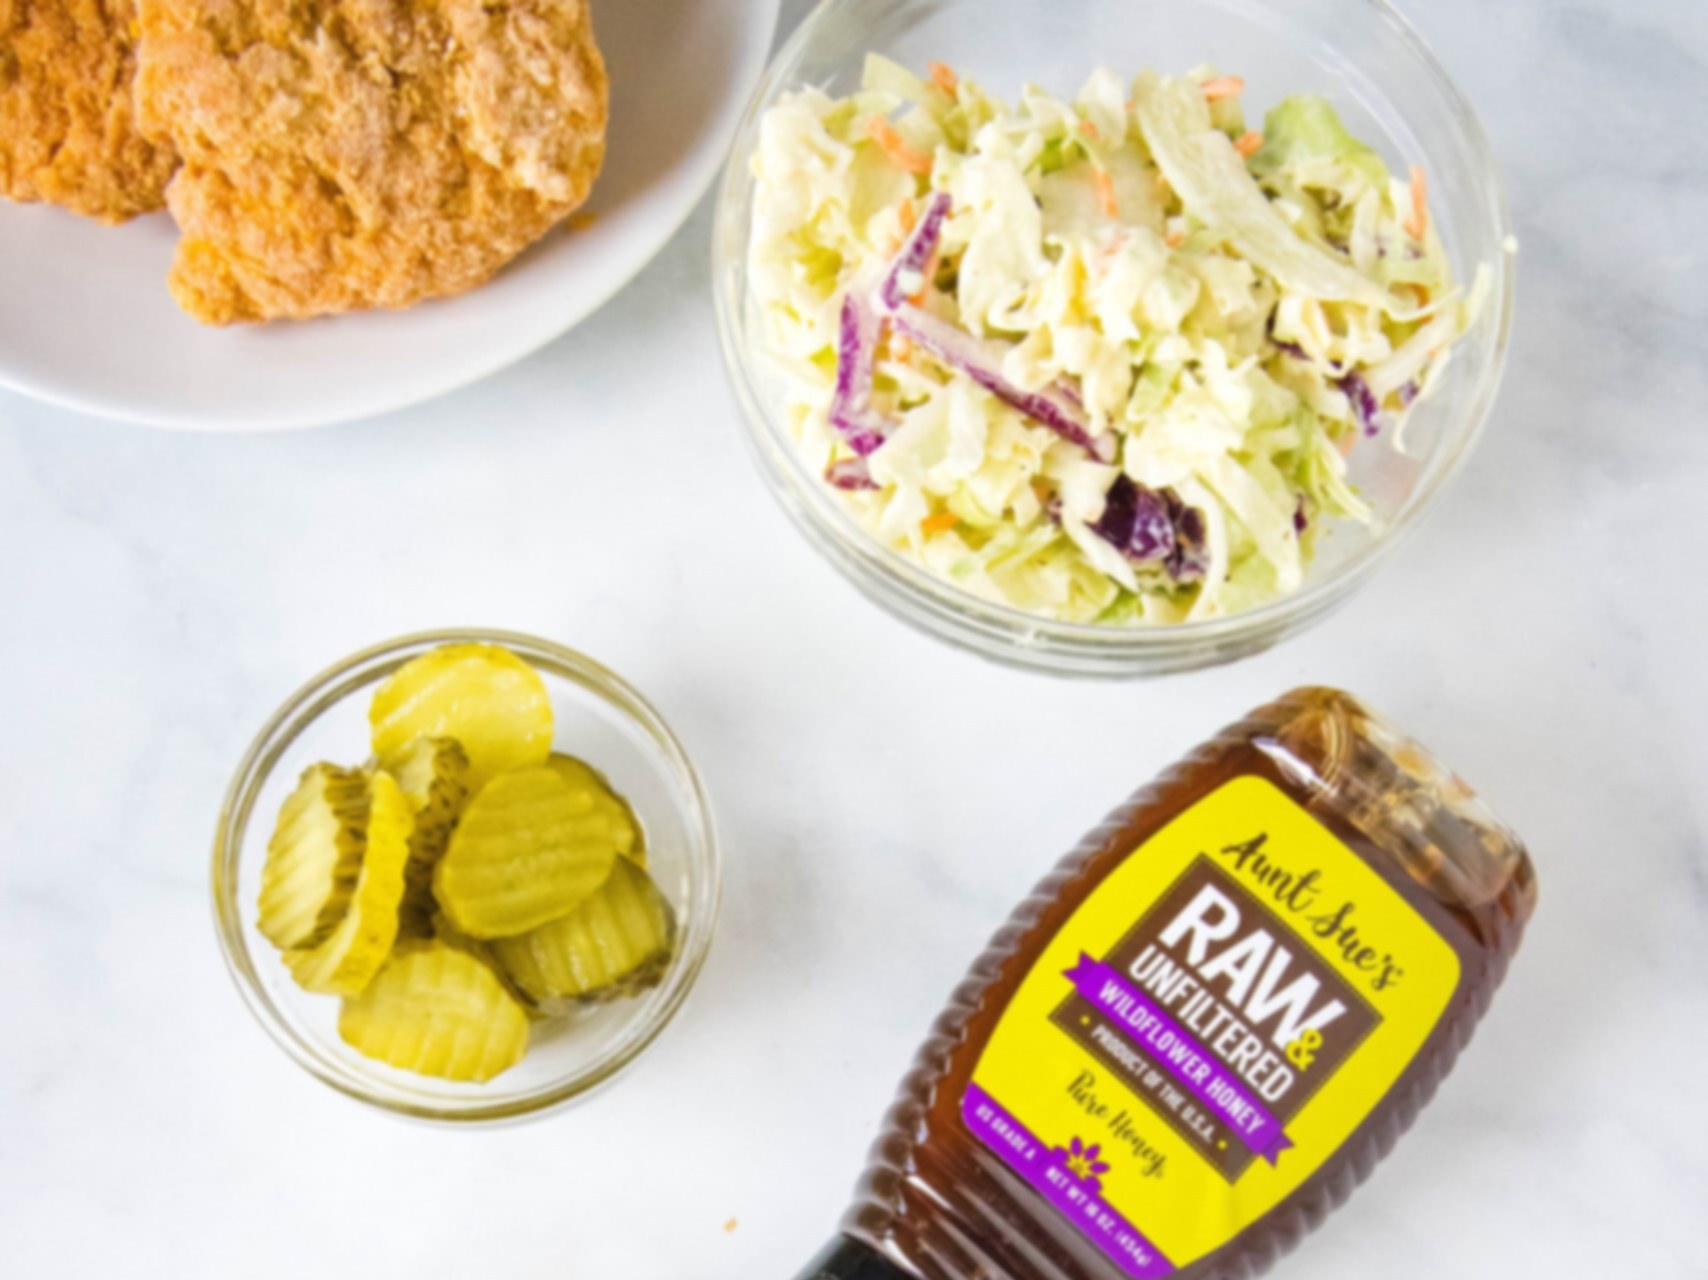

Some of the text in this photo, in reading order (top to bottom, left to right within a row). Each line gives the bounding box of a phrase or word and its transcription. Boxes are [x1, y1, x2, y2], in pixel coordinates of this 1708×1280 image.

[1158, 883, 1347, 1071] RAW &
[1221, 832, 1403, 991] Aunt Sue's
[1091, 1024, 1216, 1143] PRODUCT OF THE U.S.A.
[1099, 980, 1266, 1134] WILDFLOWER HONEY
[1129, 944, 1294, 1103] UNFILTERED
[991, 1118, 1027, 1152] GRADE
[1025, 1148, 1036, 1161] A
[1046, 1167, 1070, 1189] NET
[1067, 1186, 1088, 1205] WT
[1067, 1070, 1167, 1178] Pure Honey
